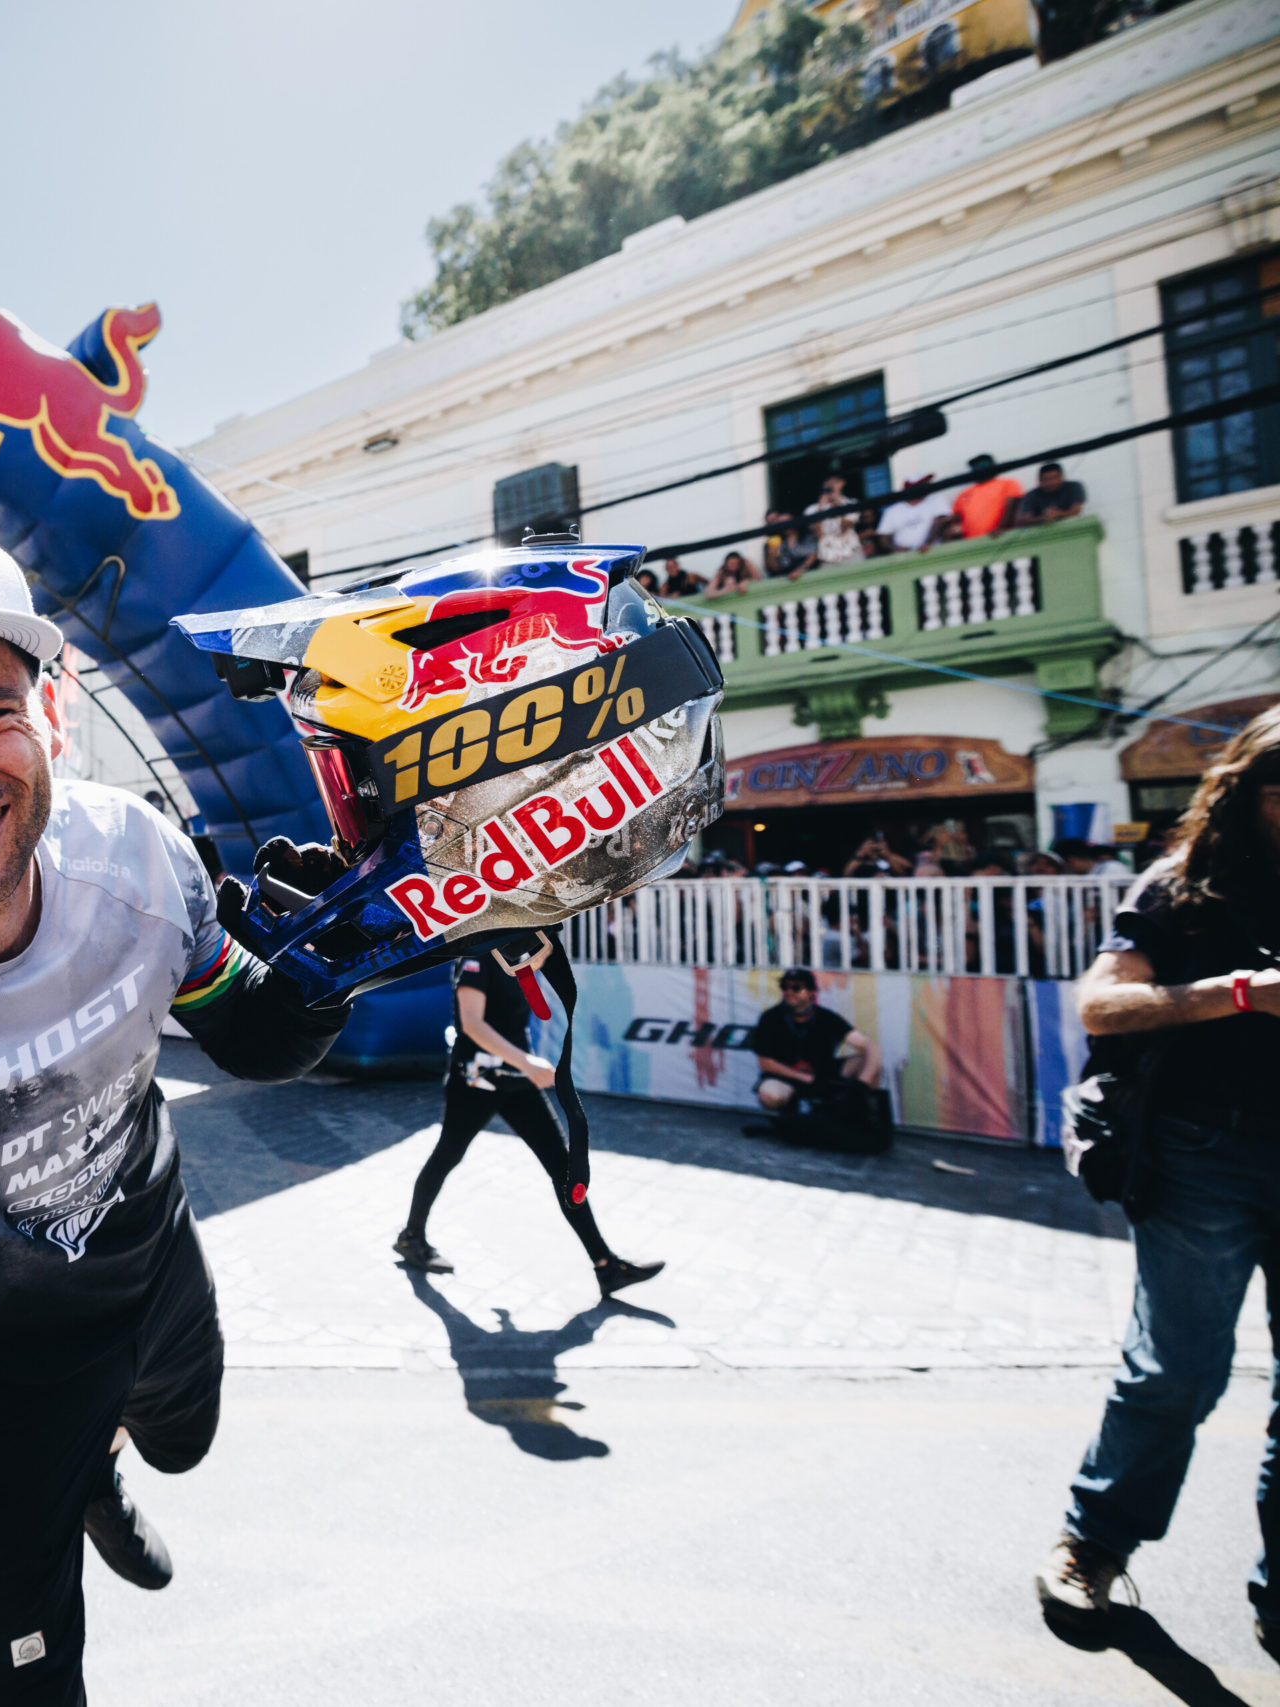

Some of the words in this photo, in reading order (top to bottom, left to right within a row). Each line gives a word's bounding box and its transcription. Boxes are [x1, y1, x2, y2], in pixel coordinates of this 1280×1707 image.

[384, 654, 646, 803] 100%
[747, 749, 948, 794] CINZANO
[387, 816, 538, 940] Red
[508, 733, 665, 869] Bull
[622, 1017, 760, 1052] GHO
[0, 1120, 52, 1167] DT
[61, 1063, 139, 1136] SWISS
